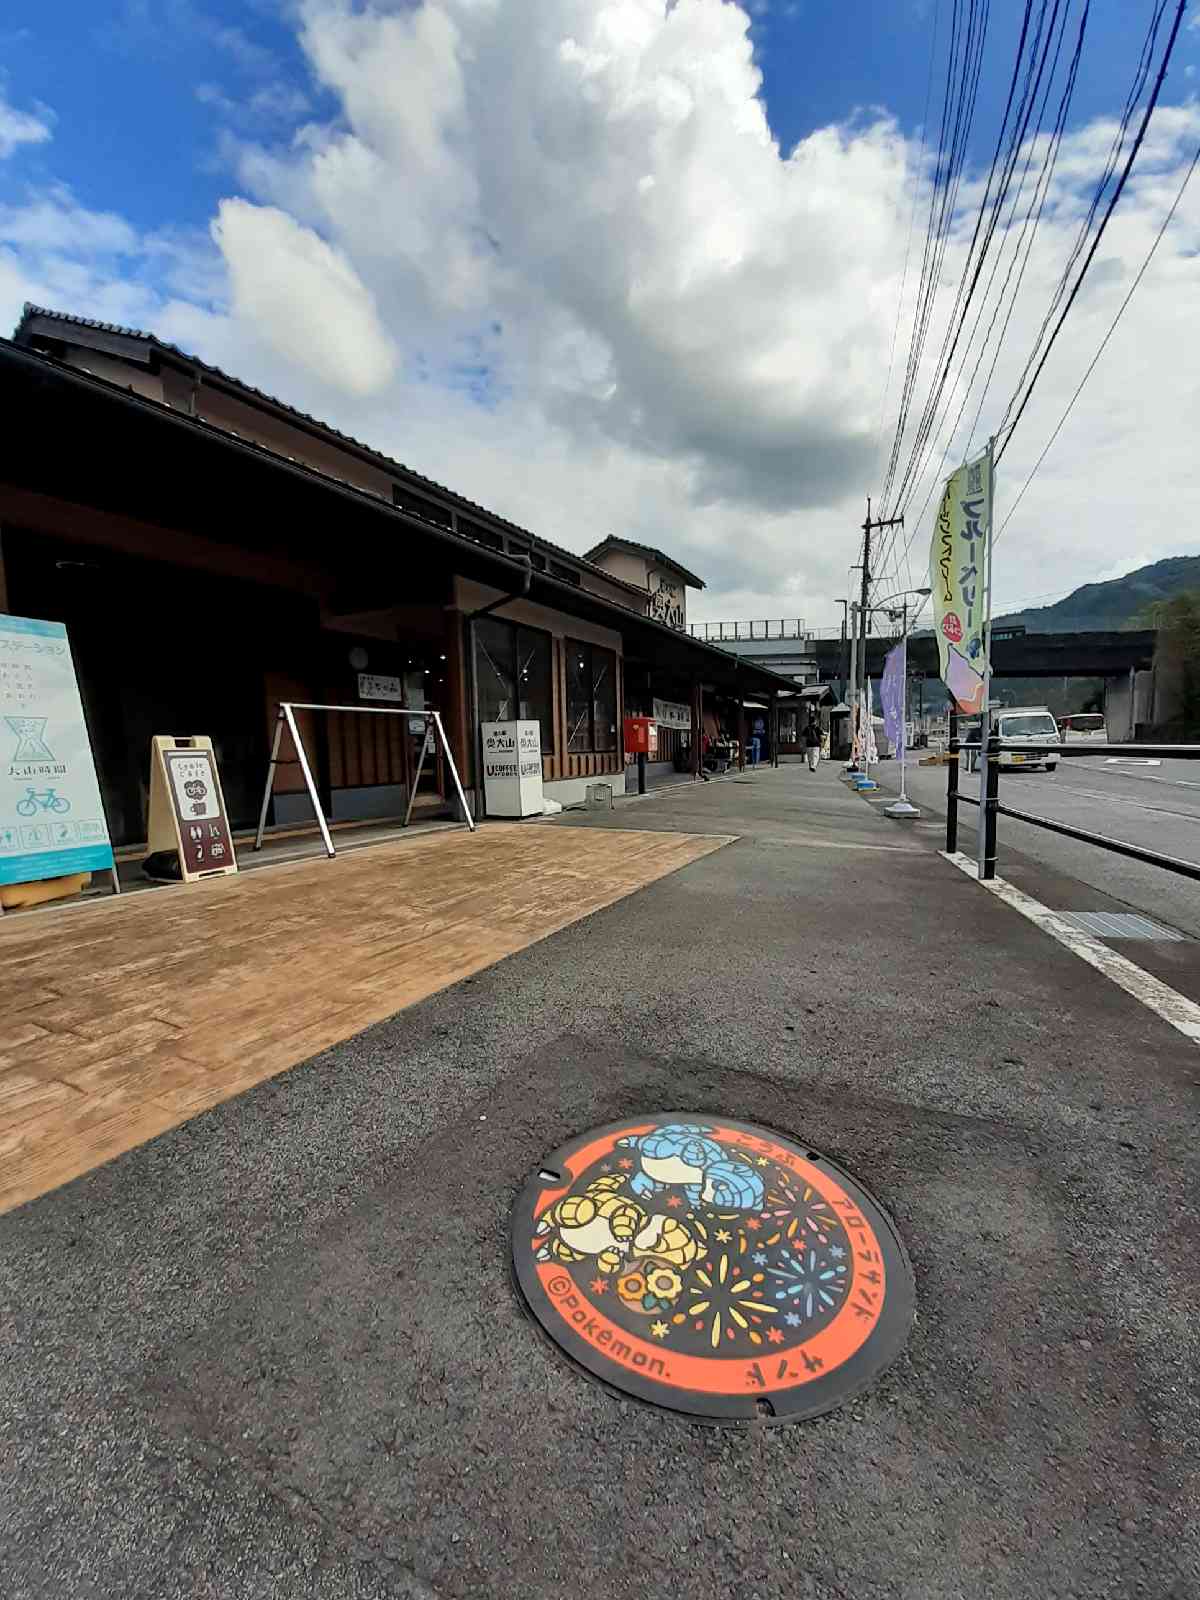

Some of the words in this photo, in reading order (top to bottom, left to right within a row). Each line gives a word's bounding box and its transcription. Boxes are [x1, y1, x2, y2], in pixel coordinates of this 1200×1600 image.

[831, 1198, 881, 1321] アローラサンド
[745, 1349, 825, 1388] サンド
